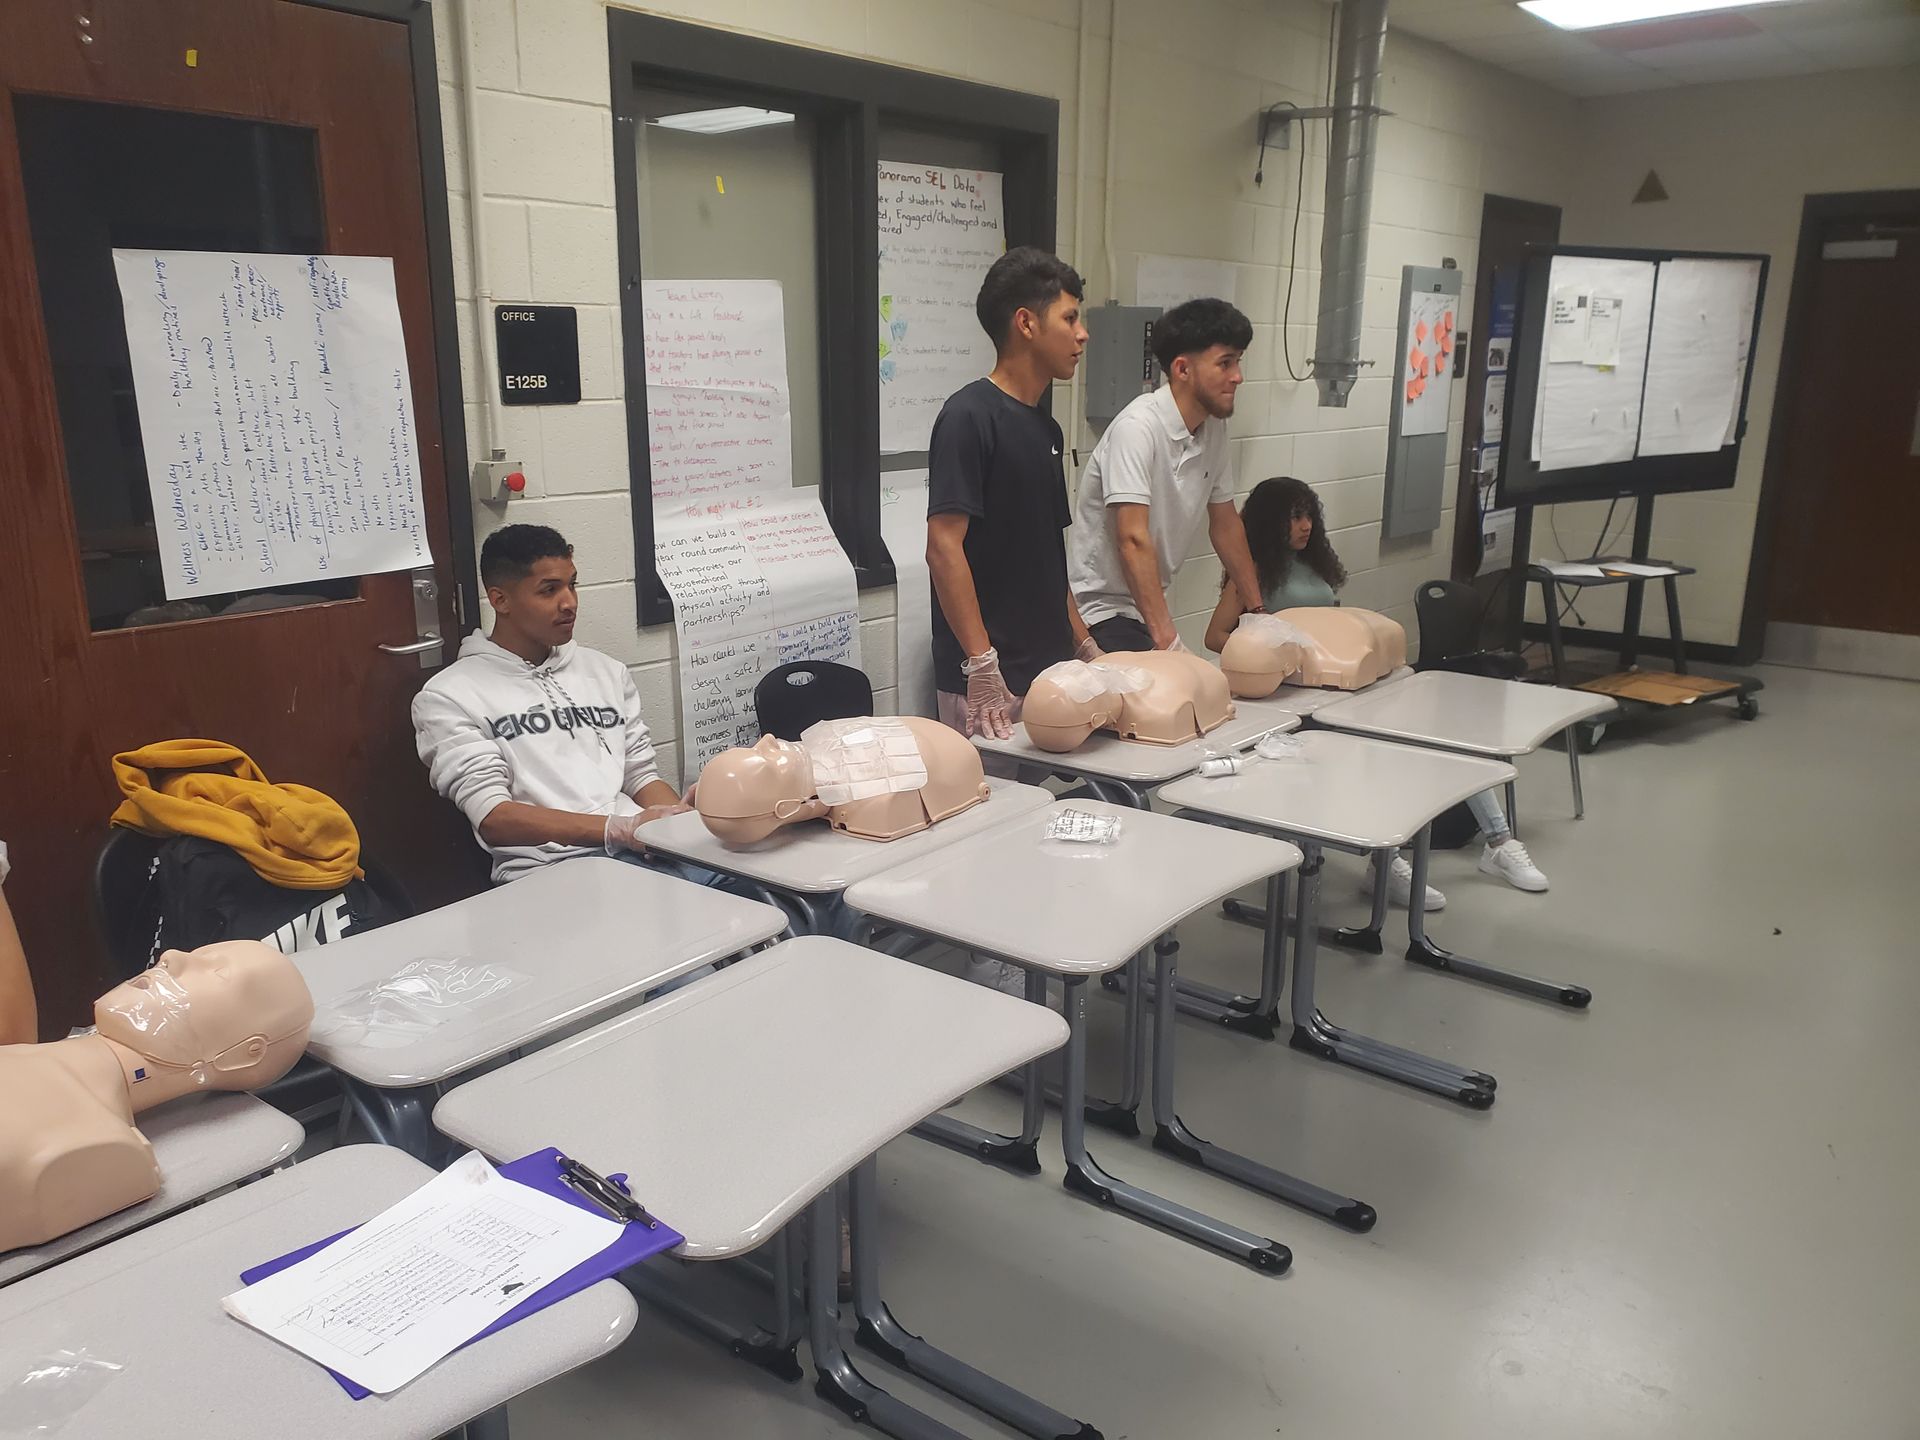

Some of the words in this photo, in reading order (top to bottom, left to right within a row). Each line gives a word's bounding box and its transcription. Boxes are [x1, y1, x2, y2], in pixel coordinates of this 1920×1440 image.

[925, 170, 946, 190] SEL
[953, 174, 976, 193] Data
[896, 190, 904, 203] of
[908, 194, 945, 206] students
[950, 199, 967, 209] who
[970, 199, 986, 211] feel
[981, 217, 998, 230] and
[501, 311, 536, 322] OFFICE
[287, 360, 299, 399] building
[505, 375, 548, 389] E125B
[167, 461, 187, 530] Wednesday
[302, 492, 324, 527] physical
[308, 535, 321, 544] of
[671, 537, 688, 547] can
[691, 535, 705, 545] we
[706, 528, 728, 540] build
[181, 542, 198, 584] Wellness
[256, 539, 273, 572] School
[656, 553, 675, 566] year
[681, 546, 707, 559] round
[708, 541, 747, 555] community
[661, 565, 683, 579] that
[685, 561, 725, 577] improves
[727, 557, 743, 566] our
[675, 583, 733, 600] relationships
[737, 575, 768, 589] through
[679, 596, 715, 619] physical
[719, 590, 753, 606] activity
[757, 585, 771, 597] and
[682, 604, 746, 636] partnerships?
[690, 652, 709, 669] How
[743, 642, 757, 653] we
[691, 677, 722, 695] design
[725, 673, 732, 681] a
[734, 662, 753, 678] safe
